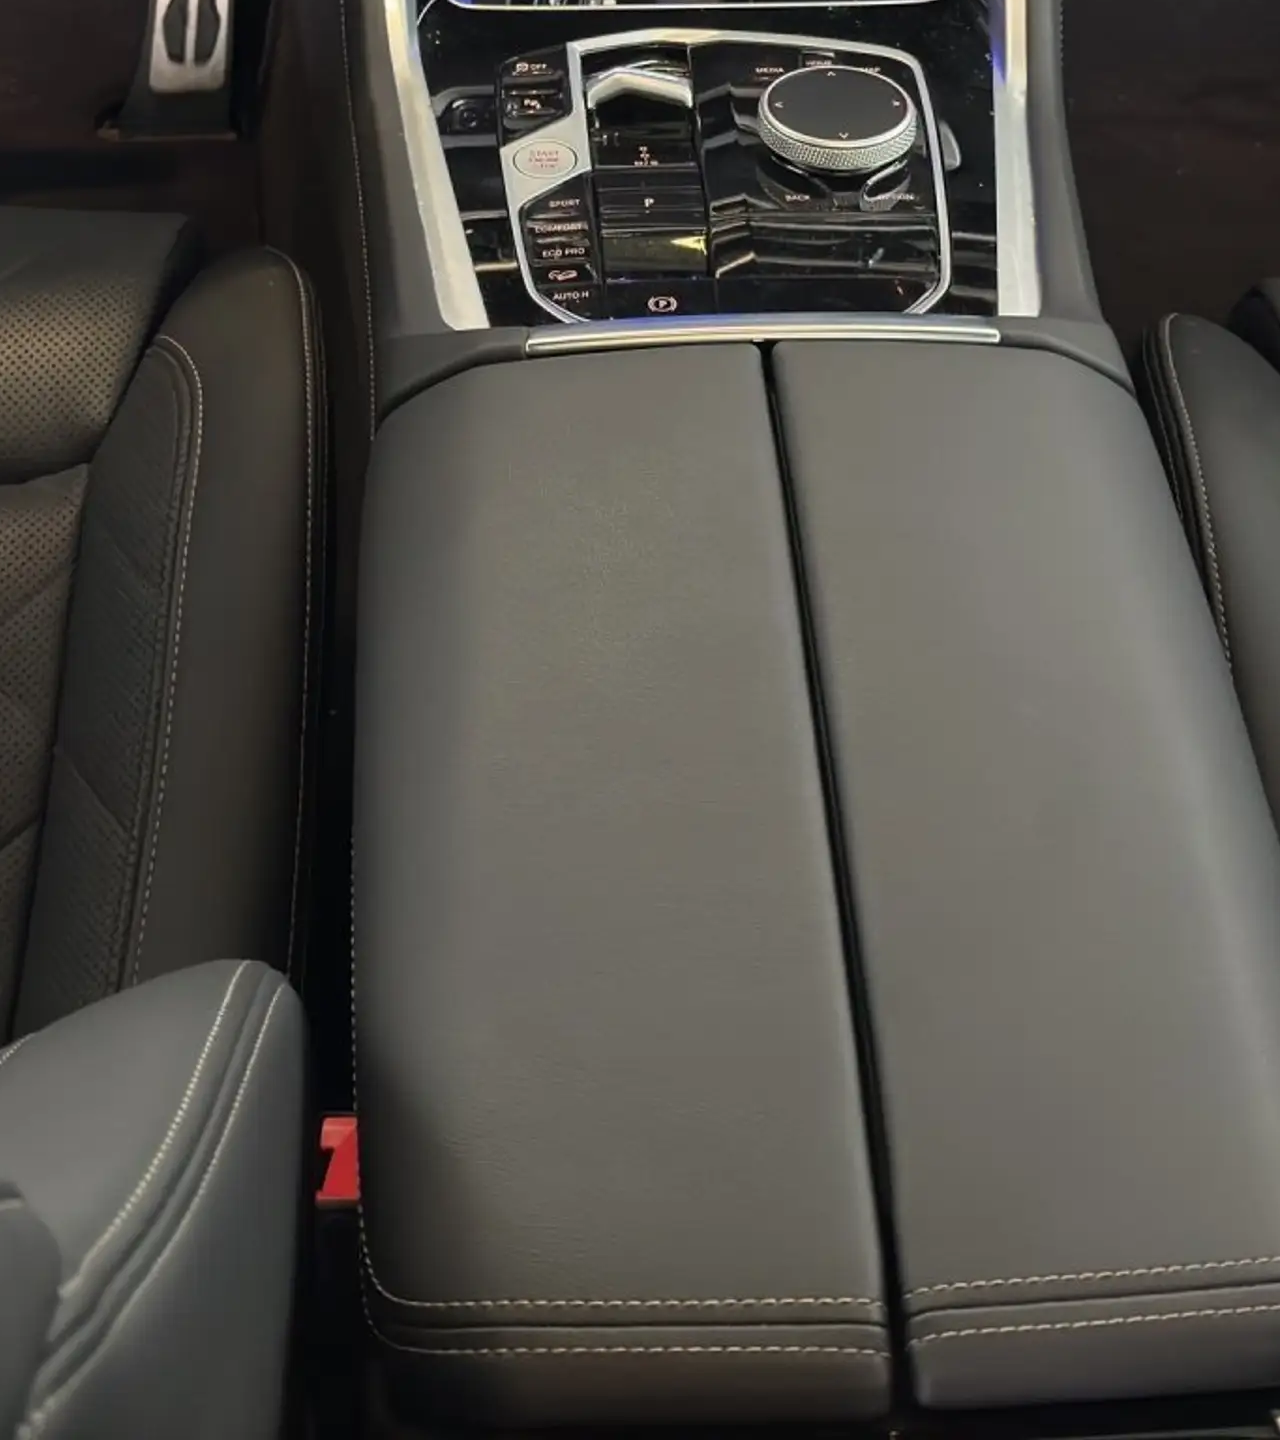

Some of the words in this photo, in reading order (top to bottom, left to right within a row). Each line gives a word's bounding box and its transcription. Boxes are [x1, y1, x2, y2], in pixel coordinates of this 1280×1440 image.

[530, 63, 548, 71] OFF
[548, 198, 581, 209] SPORT
[643, 197, 655, 208] P
[541, 248, 563, 258] ECO
[564, 247, 586, 257] PRO
[552, 291, 580, 301] AUTO
[581, 290, 589, 299] H
